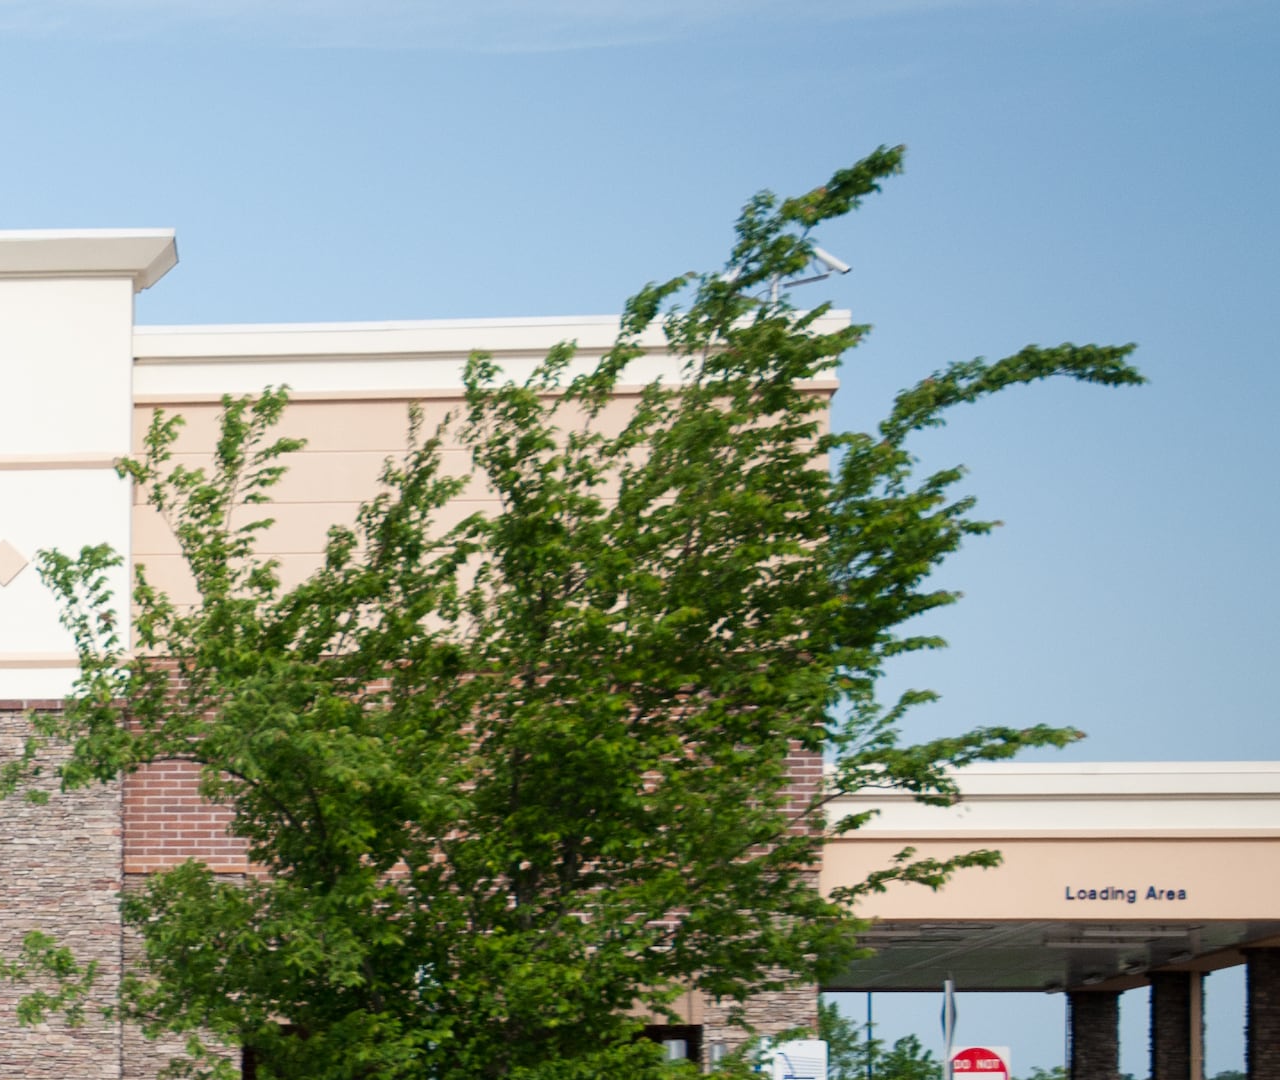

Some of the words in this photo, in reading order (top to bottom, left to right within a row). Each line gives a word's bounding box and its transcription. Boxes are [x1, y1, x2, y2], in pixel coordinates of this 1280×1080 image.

[1065, 886, 1137, 904] Loading
[1145, 885, 1187, 901] Area
[953, 1059, 971, 1070] DO
[976, 1059, 1000, 1070] NOT
